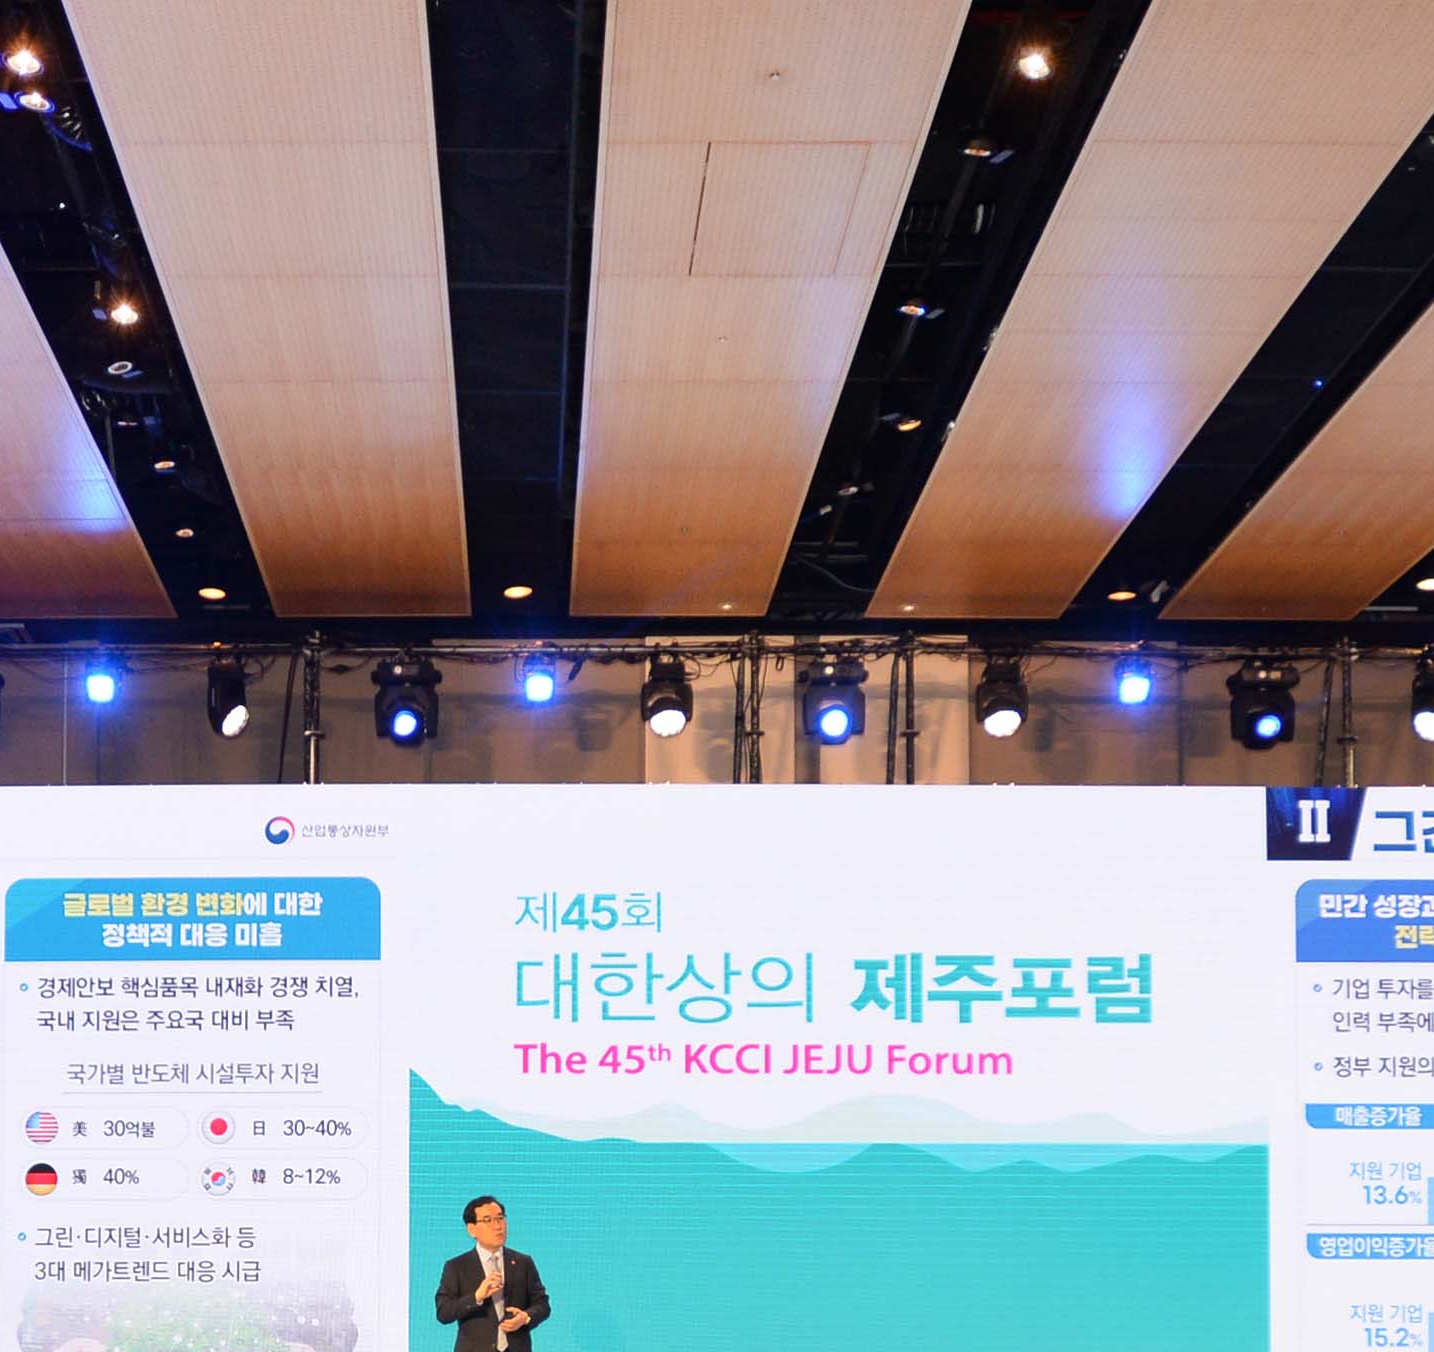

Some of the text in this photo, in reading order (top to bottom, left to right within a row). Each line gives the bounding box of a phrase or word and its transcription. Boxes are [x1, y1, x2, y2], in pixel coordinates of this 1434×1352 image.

[62, 891, 324, 918] 글로벌 환경 변화에 대한
[514, 891, 662, 934] 제45회
[1317, 893, 1369, 919] 민간
[101, 920, 283, 949] 정책적 대응 미흡
[37, 977, 116, 999] 경제안보
[120, 976, 199, 999] 핵심품목
[205, 976, 264, 998] 내재화
[270, 976, 309, 999] 경쟁
[516, 951, 1153, 1025] 대한상의 제주포럼
[36, 1009, 296, 1032] 국내 지원은 주요국 대비 부족
[513, 1041, 588, 1075] The
[684, 1043, 772, 1075] KCCI
[782, 1043, 873, 1076] JEJU
[887, 1044, 1013, 1076] Forum
[66, 1062, 320, 1086] 국가별 반도체 시설투자 지원
[103, 1119, 156, 1139] 30억불
[252, 1120, 266, 1137] 日
[102, 1167, 140, 1185] 40%
[236, 1226, 257, 1249] 등
[34, 1260, 262, 1284] 3대 메가트렌드 대응 시급
